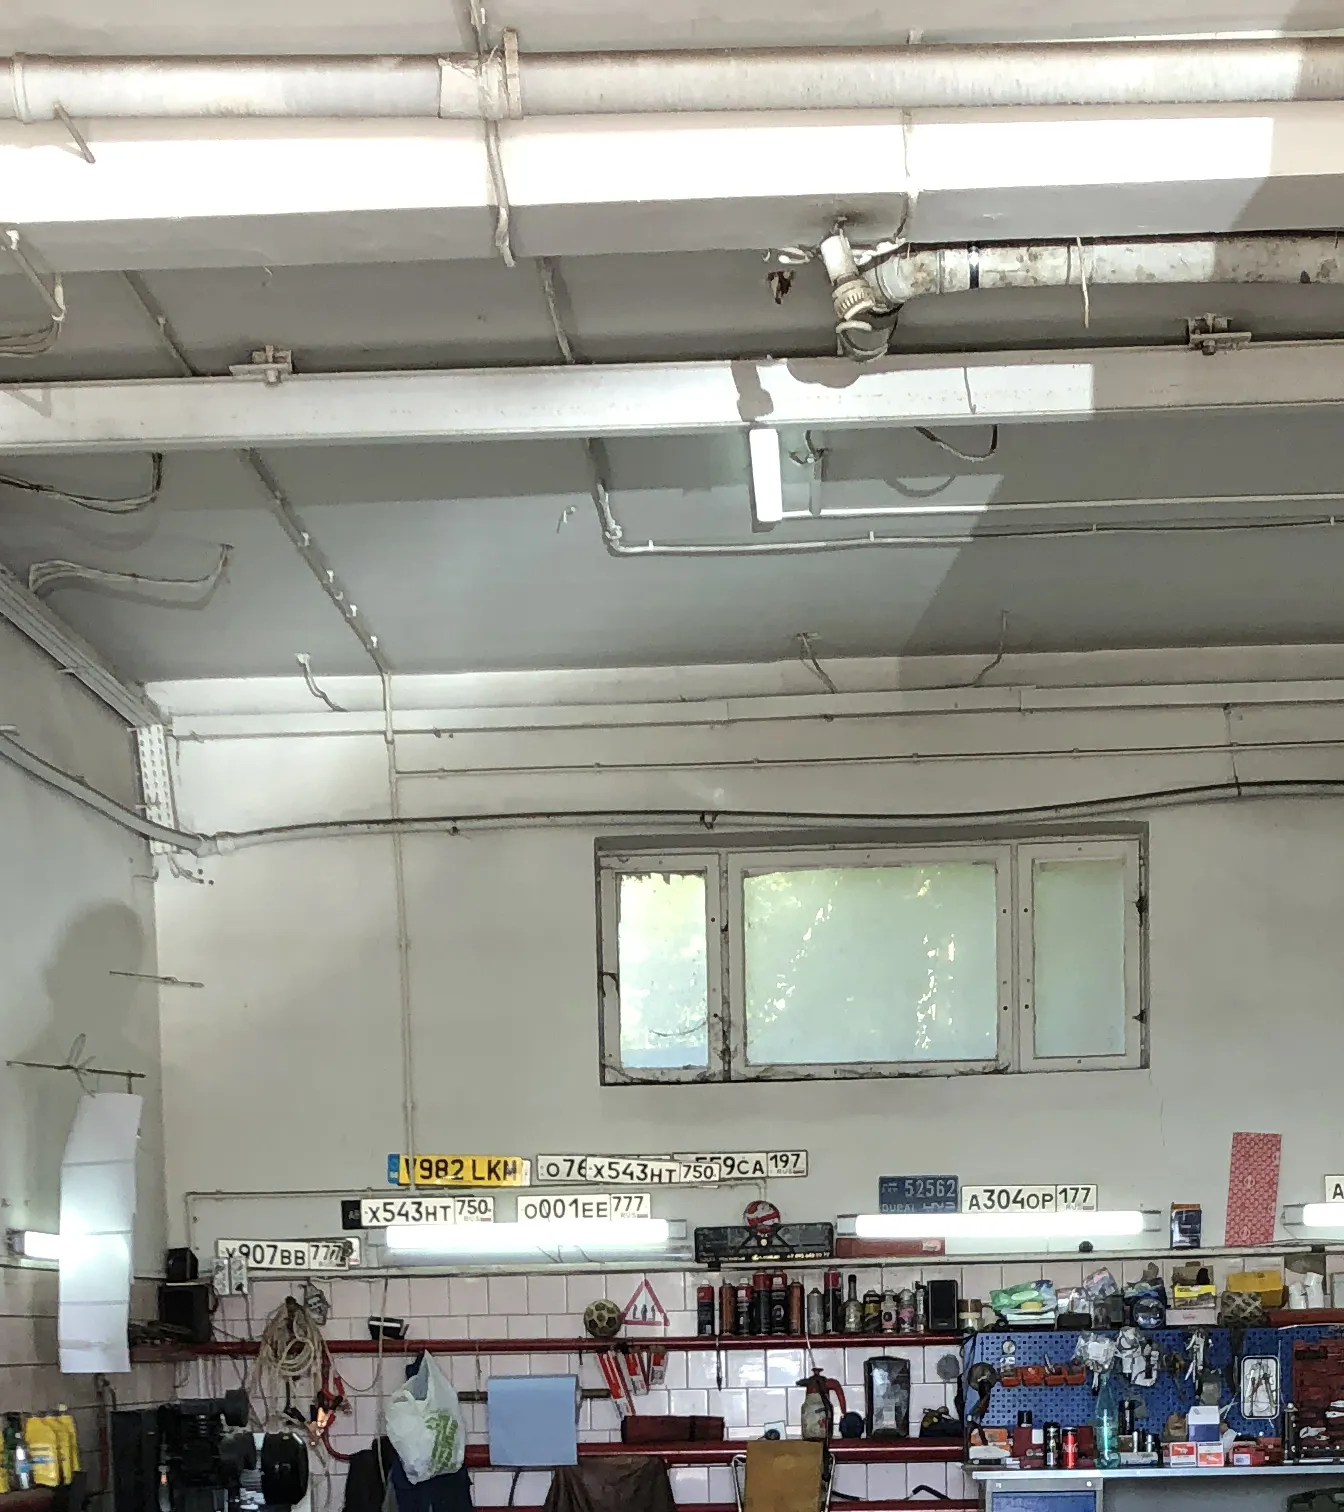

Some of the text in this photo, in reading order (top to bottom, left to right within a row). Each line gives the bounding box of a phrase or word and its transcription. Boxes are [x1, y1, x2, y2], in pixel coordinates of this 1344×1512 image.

[769, 1153, 801, 1169] 197
[682, 1164, 714, 1180] 750
[904, 1179, 957, 1198] 52562
[1058, 1187, 1092, 1203] 177
[457, 1199, 489, 1215] 750
[612, 1195, 644, 1212] 777
